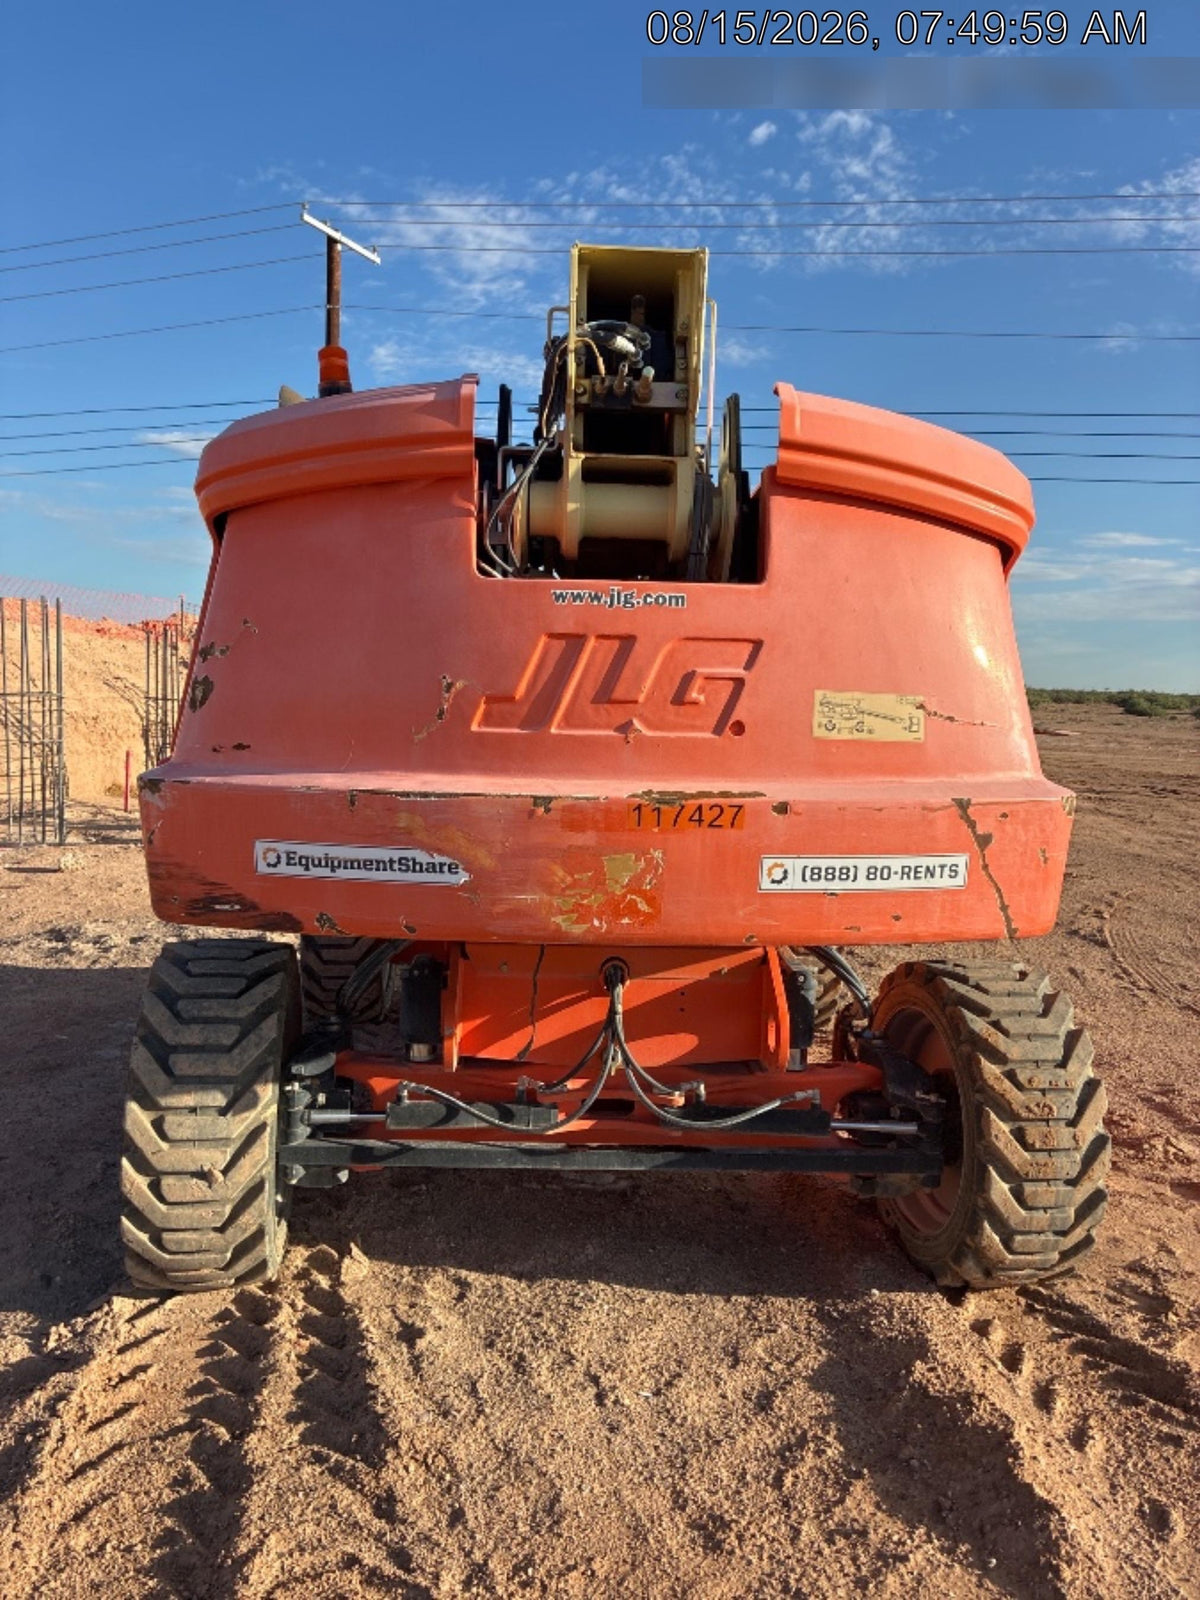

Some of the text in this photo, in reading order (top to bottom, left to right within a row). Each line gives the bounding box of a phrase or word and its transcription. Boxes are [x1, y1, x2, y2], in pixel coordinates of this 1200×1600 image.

[552, 587, 686, 609] www.jlg.com
[471, 633, 764, 736] JLG
[285, 850, 460, 875] EquipmentShare
[801, 863, 960, 882] (888) 80-RENTS
